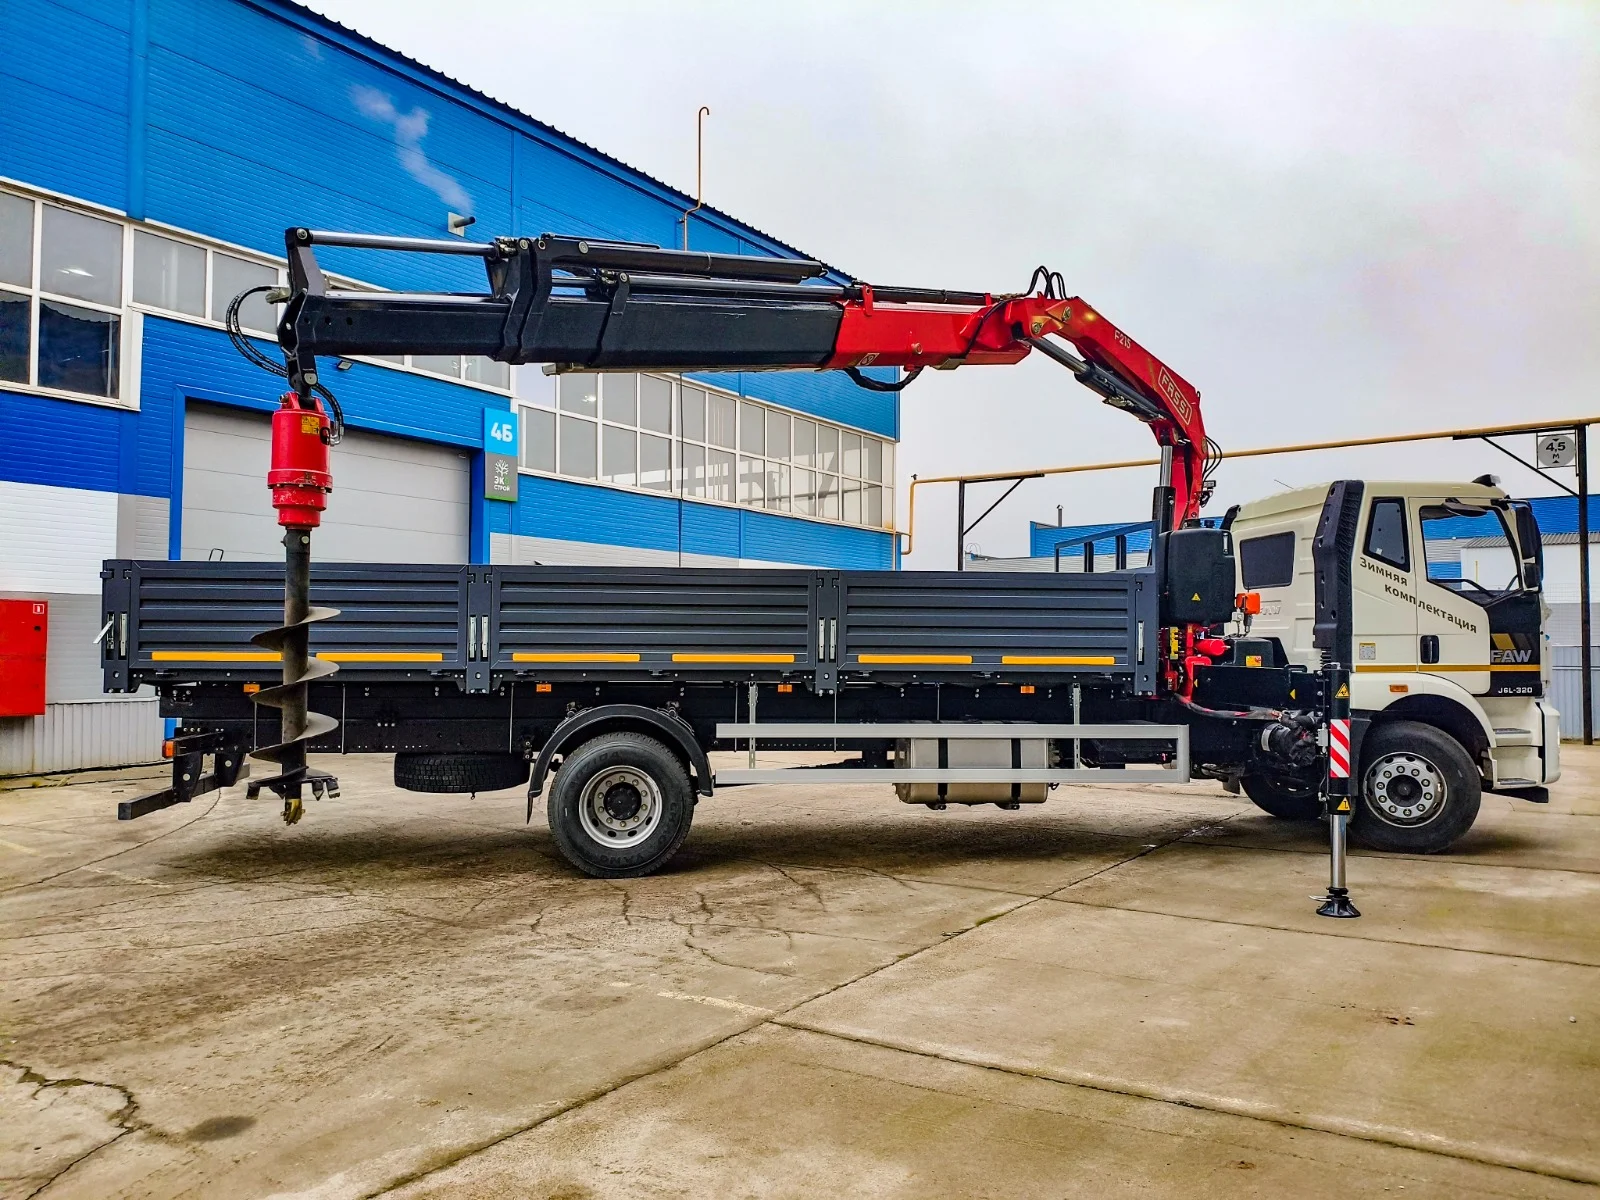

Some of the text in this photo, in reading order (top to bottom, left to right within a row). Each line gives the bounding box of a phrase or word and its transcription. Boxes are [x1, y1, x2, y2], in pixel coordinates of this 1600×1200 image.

[1114, 329, 1131, 349] F215
[1161, 374, 1190, 418] FASSI
[491, 422, 513, 442] 4Б
[1545, 442, 1566, 452] 4,5
[1360, 557, 1408, 586] Зимняя
[1384, 584, 1477, 634] комплектация
[1490, 649, 1532, 663] FAW
[1497, 686, 1533, 694] J6L-320
